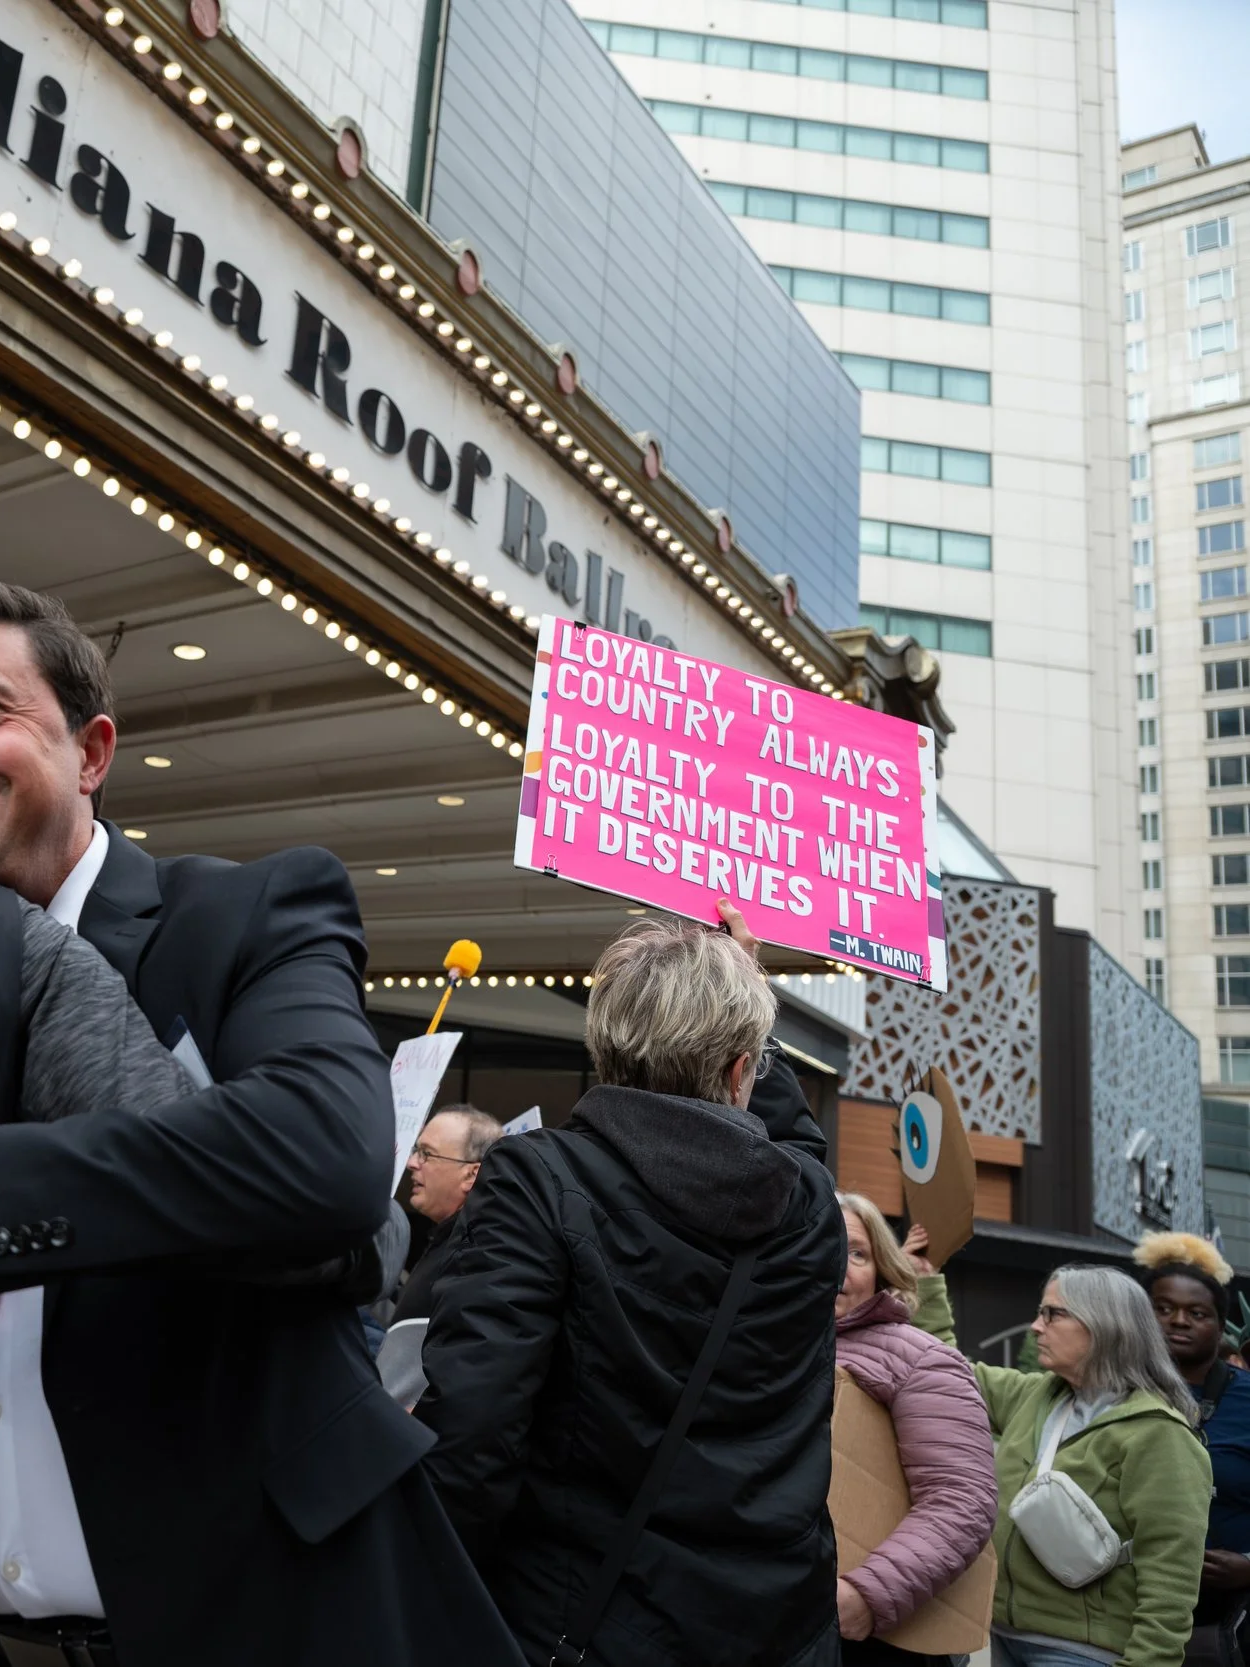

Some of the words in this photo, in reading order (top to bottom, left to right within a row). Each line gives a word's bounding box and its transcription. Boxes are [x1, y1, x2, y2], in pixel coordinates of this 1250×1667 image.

[285, 290, 493, 526] Roof
[556, 664, 735, 748] COUNTRY
[759, 726, 911, 802] ALWAYS.
[560, 624, 722, 703] LOYALTY
[744, 679, 794, 724] TO
[547, 756, 804, 868] GOVERNMENT
[816, 836, 922, 902] WHEN
[550, 714, 717, 798] LOYALTY
[744, 773, 794, 822] TO
[821, 796, 902, 855] THE
[542, 796, 585, 844] IT
[598, 816, 814, 917] DESERVES
[837, 887, 885, 939] IT.
[870, 946, 922, 975] TWAIN
